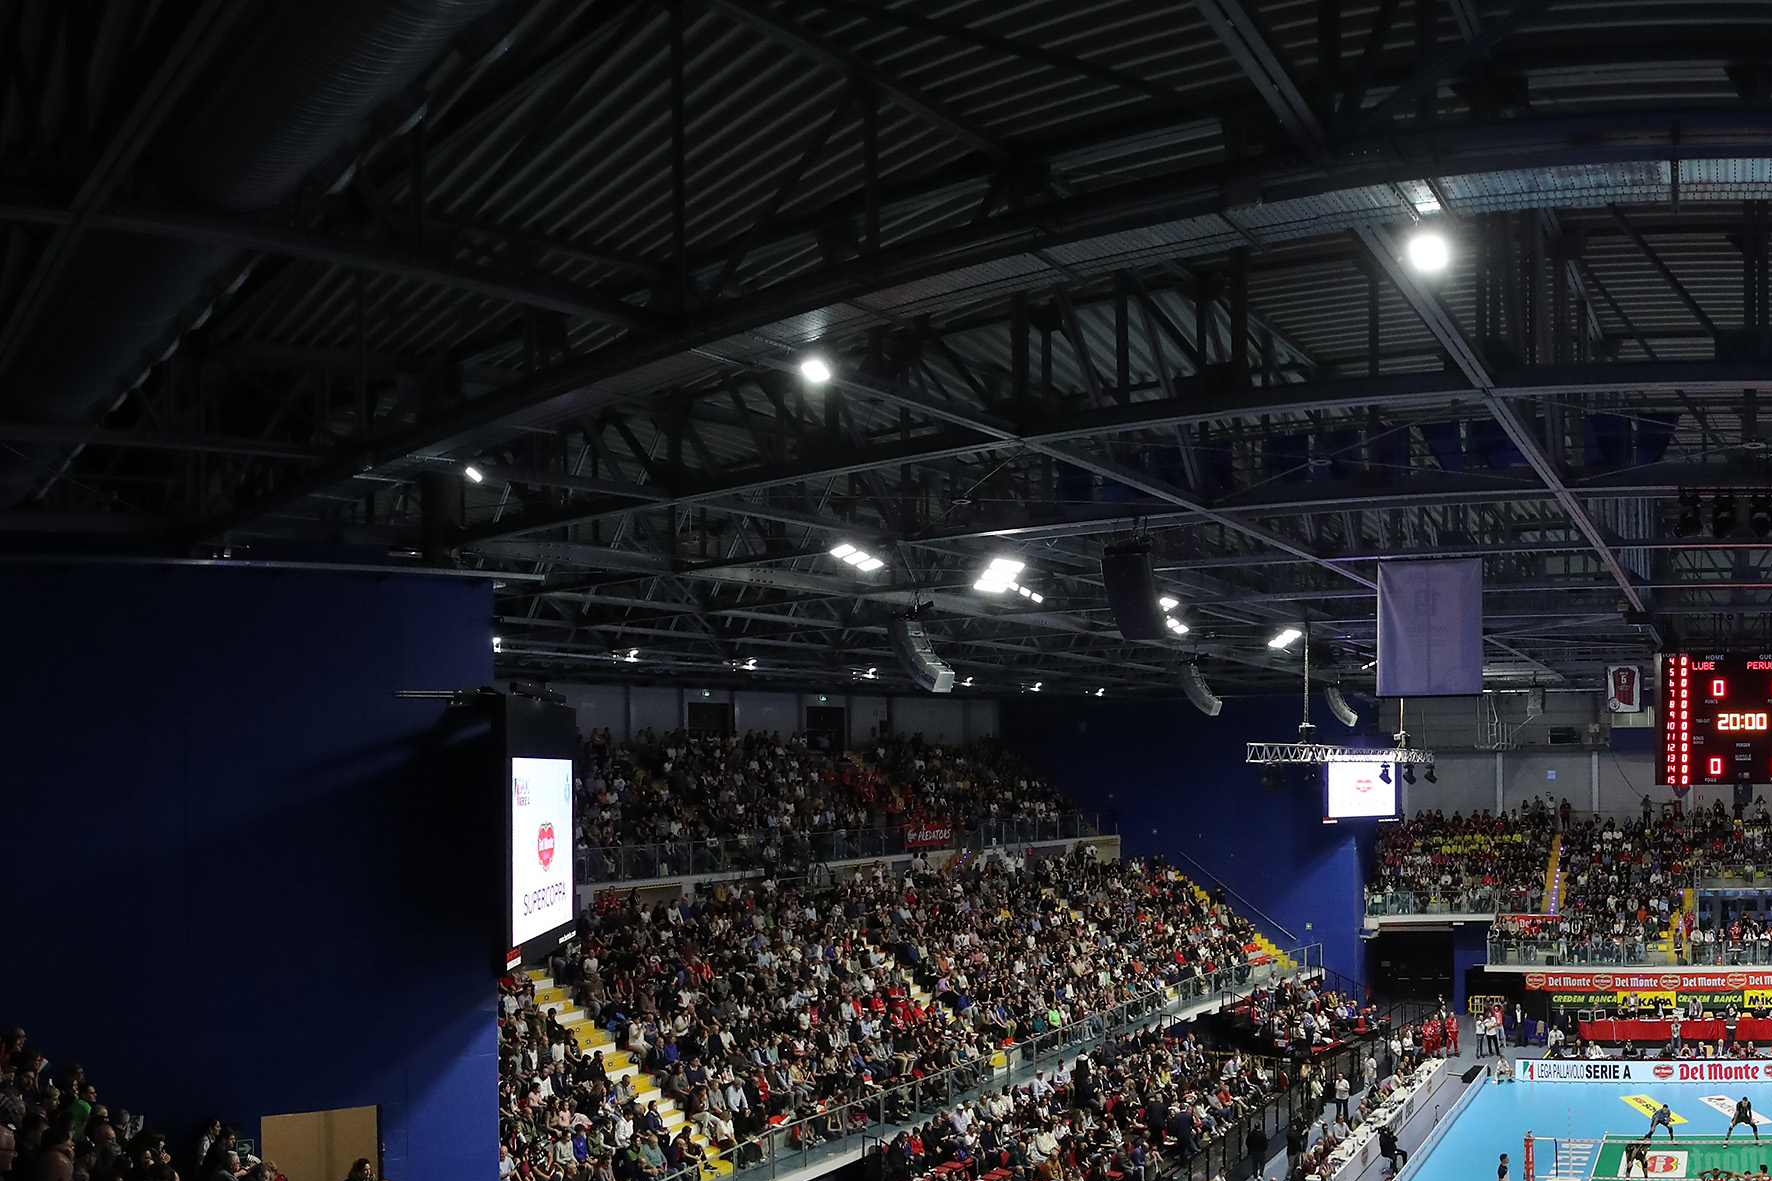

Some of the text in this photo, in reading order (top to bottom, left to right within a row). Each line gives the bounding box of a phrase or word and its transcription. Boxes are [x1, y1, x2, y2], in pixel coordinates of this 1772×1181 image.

[1669, 657, 1675, 665] 4
[1691, 661, 1716, 671] LUBE
[1669, 668, 1675, 676] 5
[1669, 679, 1675, 687] 6
[1713, 679, 1724, 696] 0
[1717, 712, 1768, 730] 20:00
[1667, 732, 1675, 740] 11
[1667, 754, 1675, 762] 13
[1710, 757, 1721, 774] 0
[1667, 776, 1675, 784] 15
[523, 881, 567, 917] SUPERCOPPA
[1548, 976, 1591, 987] Del Monte
[1615, 976, 1658, 988] Del Monte
[1682, 975, 1726, 987] Del Monte
[1749, 974, 1764, 985] Del
[1552, 995, 1618, 1003] CREDEM BANCA
[1713, 994, 1743, 1003] BANCA
[1537, 1064, 1553, 1079] LEGA
[1585, 1064, 1620, 1079] SERIE
[1623, 1064, 1632, 1079] A
[1679, 1064, 1759, 1080] Del Monte
